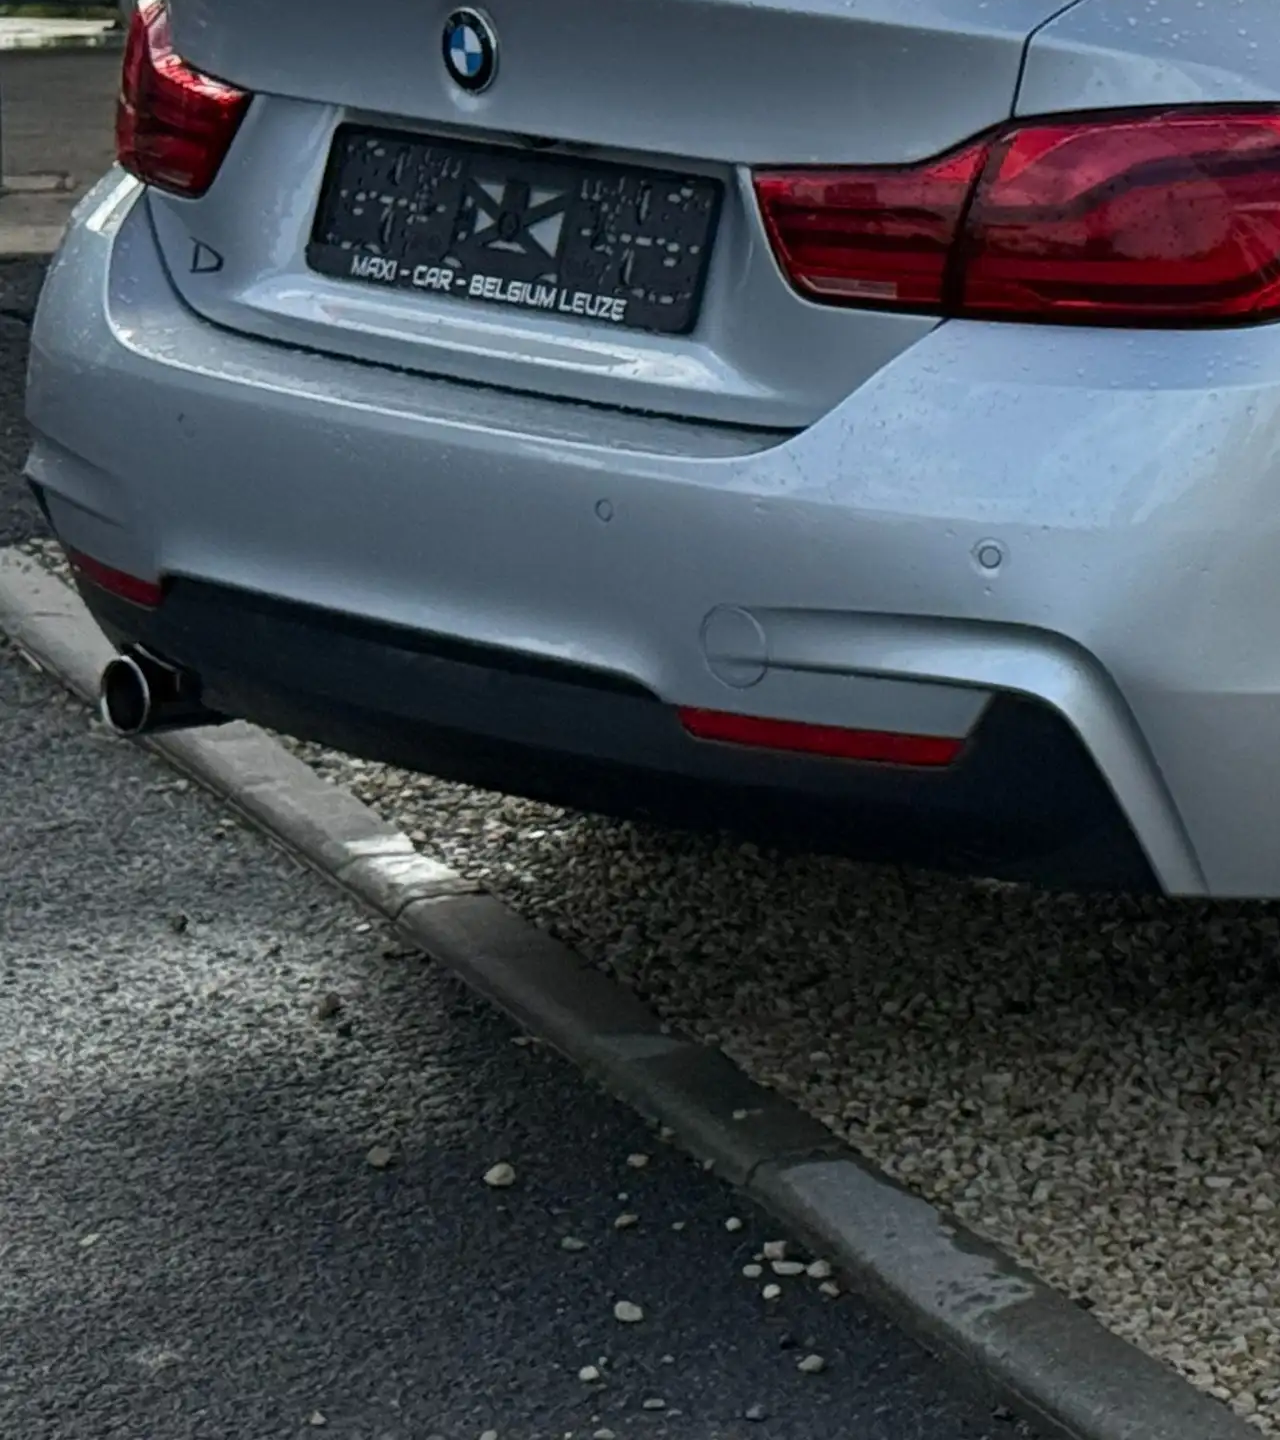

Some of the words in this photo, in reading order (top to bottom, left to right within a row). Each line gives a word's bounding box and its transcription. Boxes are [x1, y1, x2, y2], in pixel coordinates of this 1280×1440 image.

[351, 254, 398, 280] MAXI
[412, 265, 454, 291] CAR
[468, 274, 557, 309] BELGIUM
[559, 291, 628, 321] LEUZE
